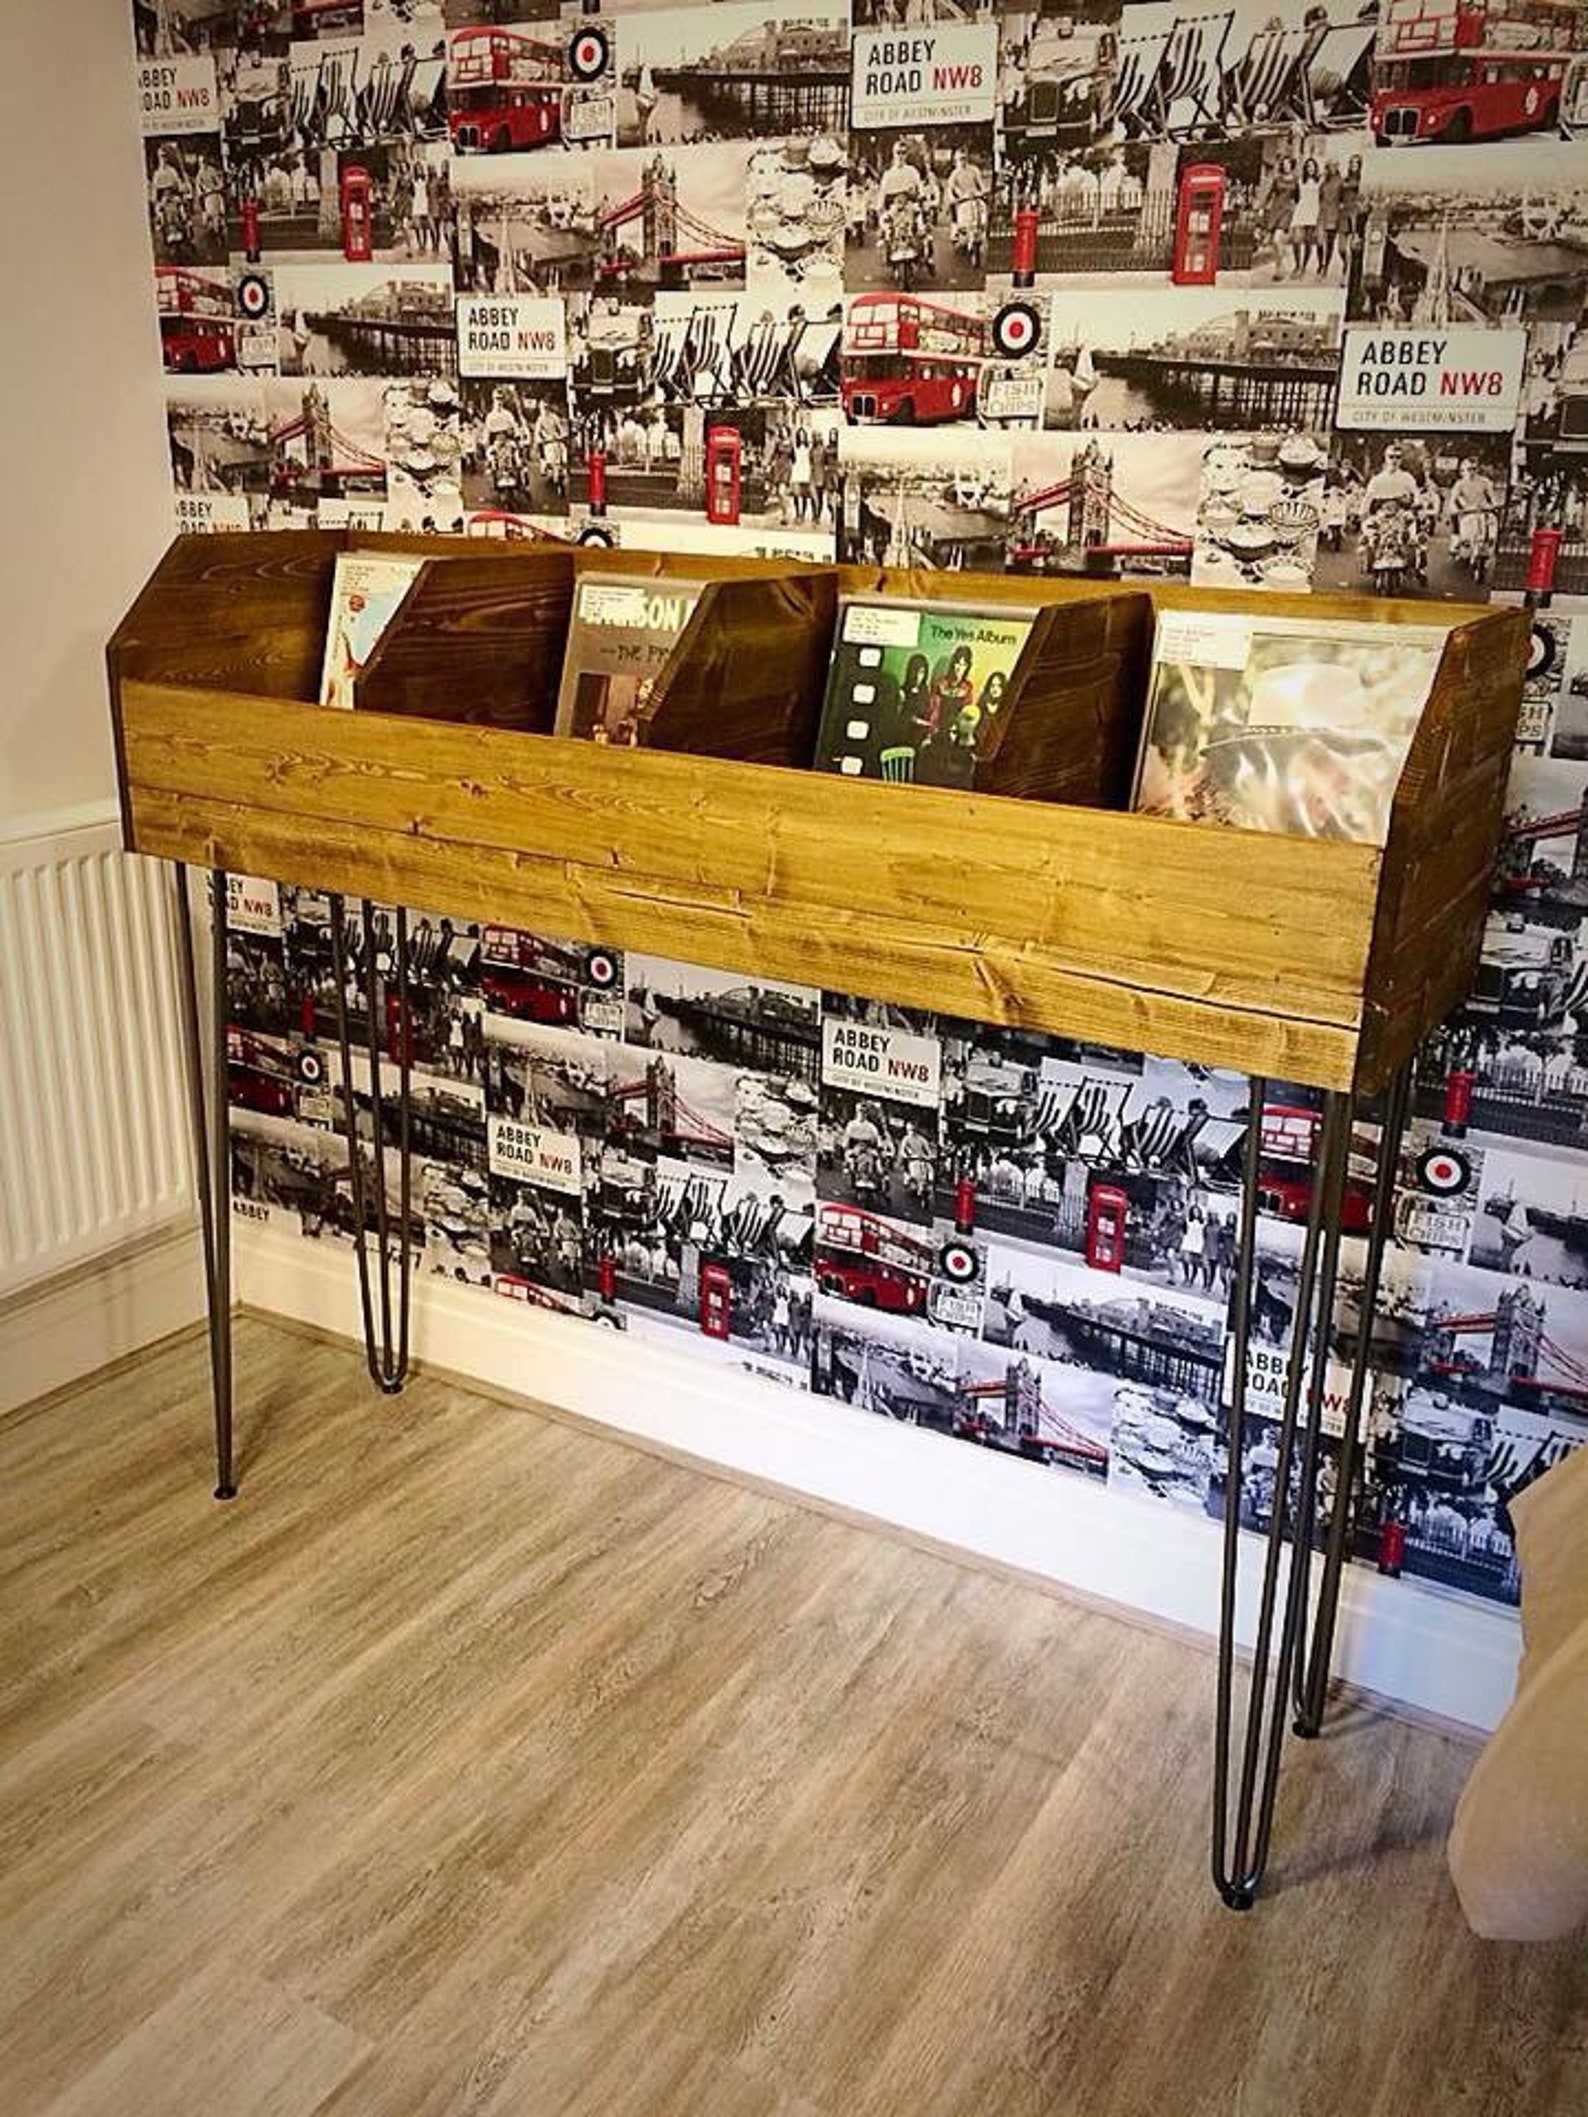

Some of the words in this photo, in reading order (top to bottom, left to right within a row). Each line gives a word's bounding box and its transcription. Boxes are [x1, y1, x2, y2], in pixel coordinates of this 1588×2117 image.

[868, 39, 936, 67] ABBEY
[866, 69, 921, 96] ROAD
[933, 64, 983, 90] NW8
[142, 88, 171, 112] OAD
[176, 87, 210, 108] NW8
[468, 307, 518, 327] ABBEY
[468, 331, 510, 351] ROAD
[517, 330, 555, 351] NW8
[1361, 340, 1448, 365] ABBEY
[1357, 371, 1427, 396] ROAD
[1440, 371, 1503, 396] NW8
[176, 499, 212, 518] BBEY
[931, 625, 953, 640] The
[976, 630, 1017, 645] Album
[244, 898, 272, 917] NW8
[834, 1028, 891, 1053] ABBEY
[833, 1047, 880, 1073] ROAD
[888, 1059, 930, 1083] NW8
[496, 1125, 541, 1147] ABBEY
[497, 1142, 533, 1165] ROAD
[540, 1153, 572, 1175] NW8
